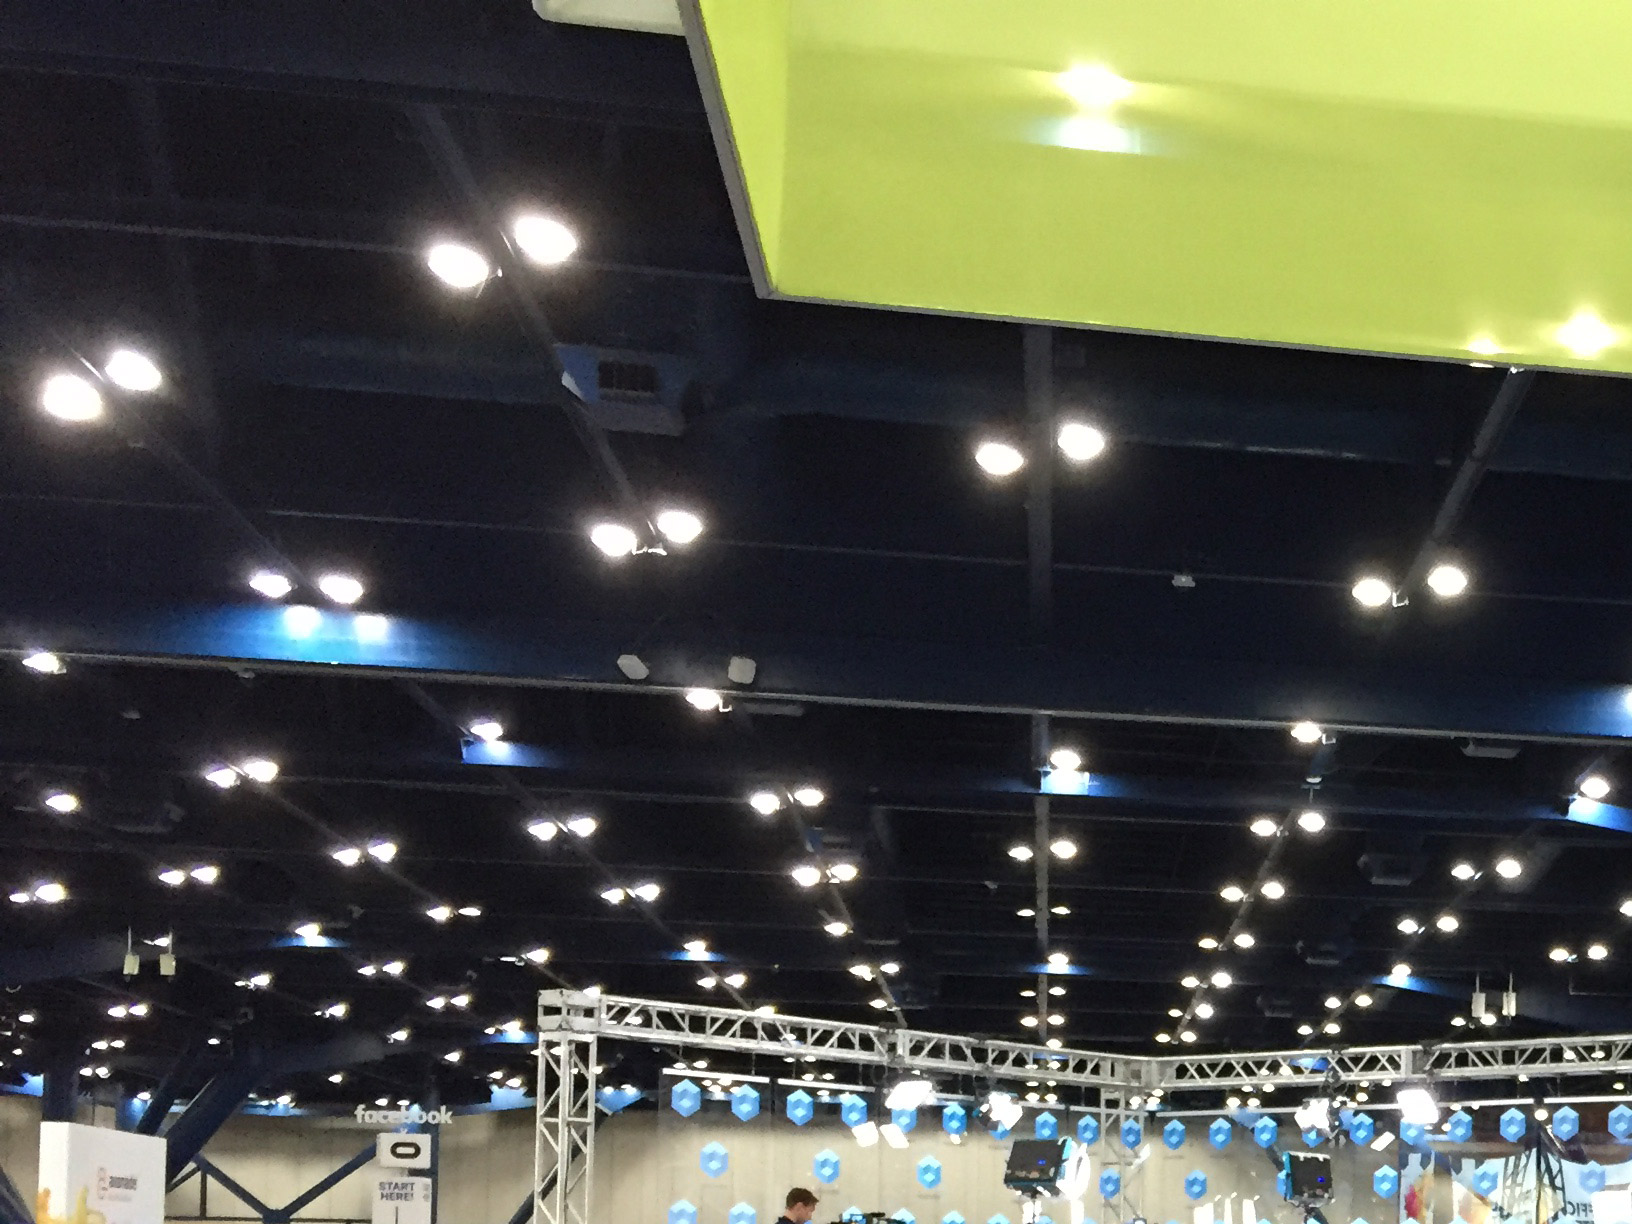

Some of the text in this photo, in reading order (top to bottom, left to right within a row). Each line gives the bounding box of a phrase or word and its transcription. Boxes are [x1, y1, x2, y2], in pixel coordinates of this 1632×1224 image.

[354, 1104, 453, 1124] facebook
[379, 1181, 415, 1192] START
[380, 1192, 414, 1201] HERE!
